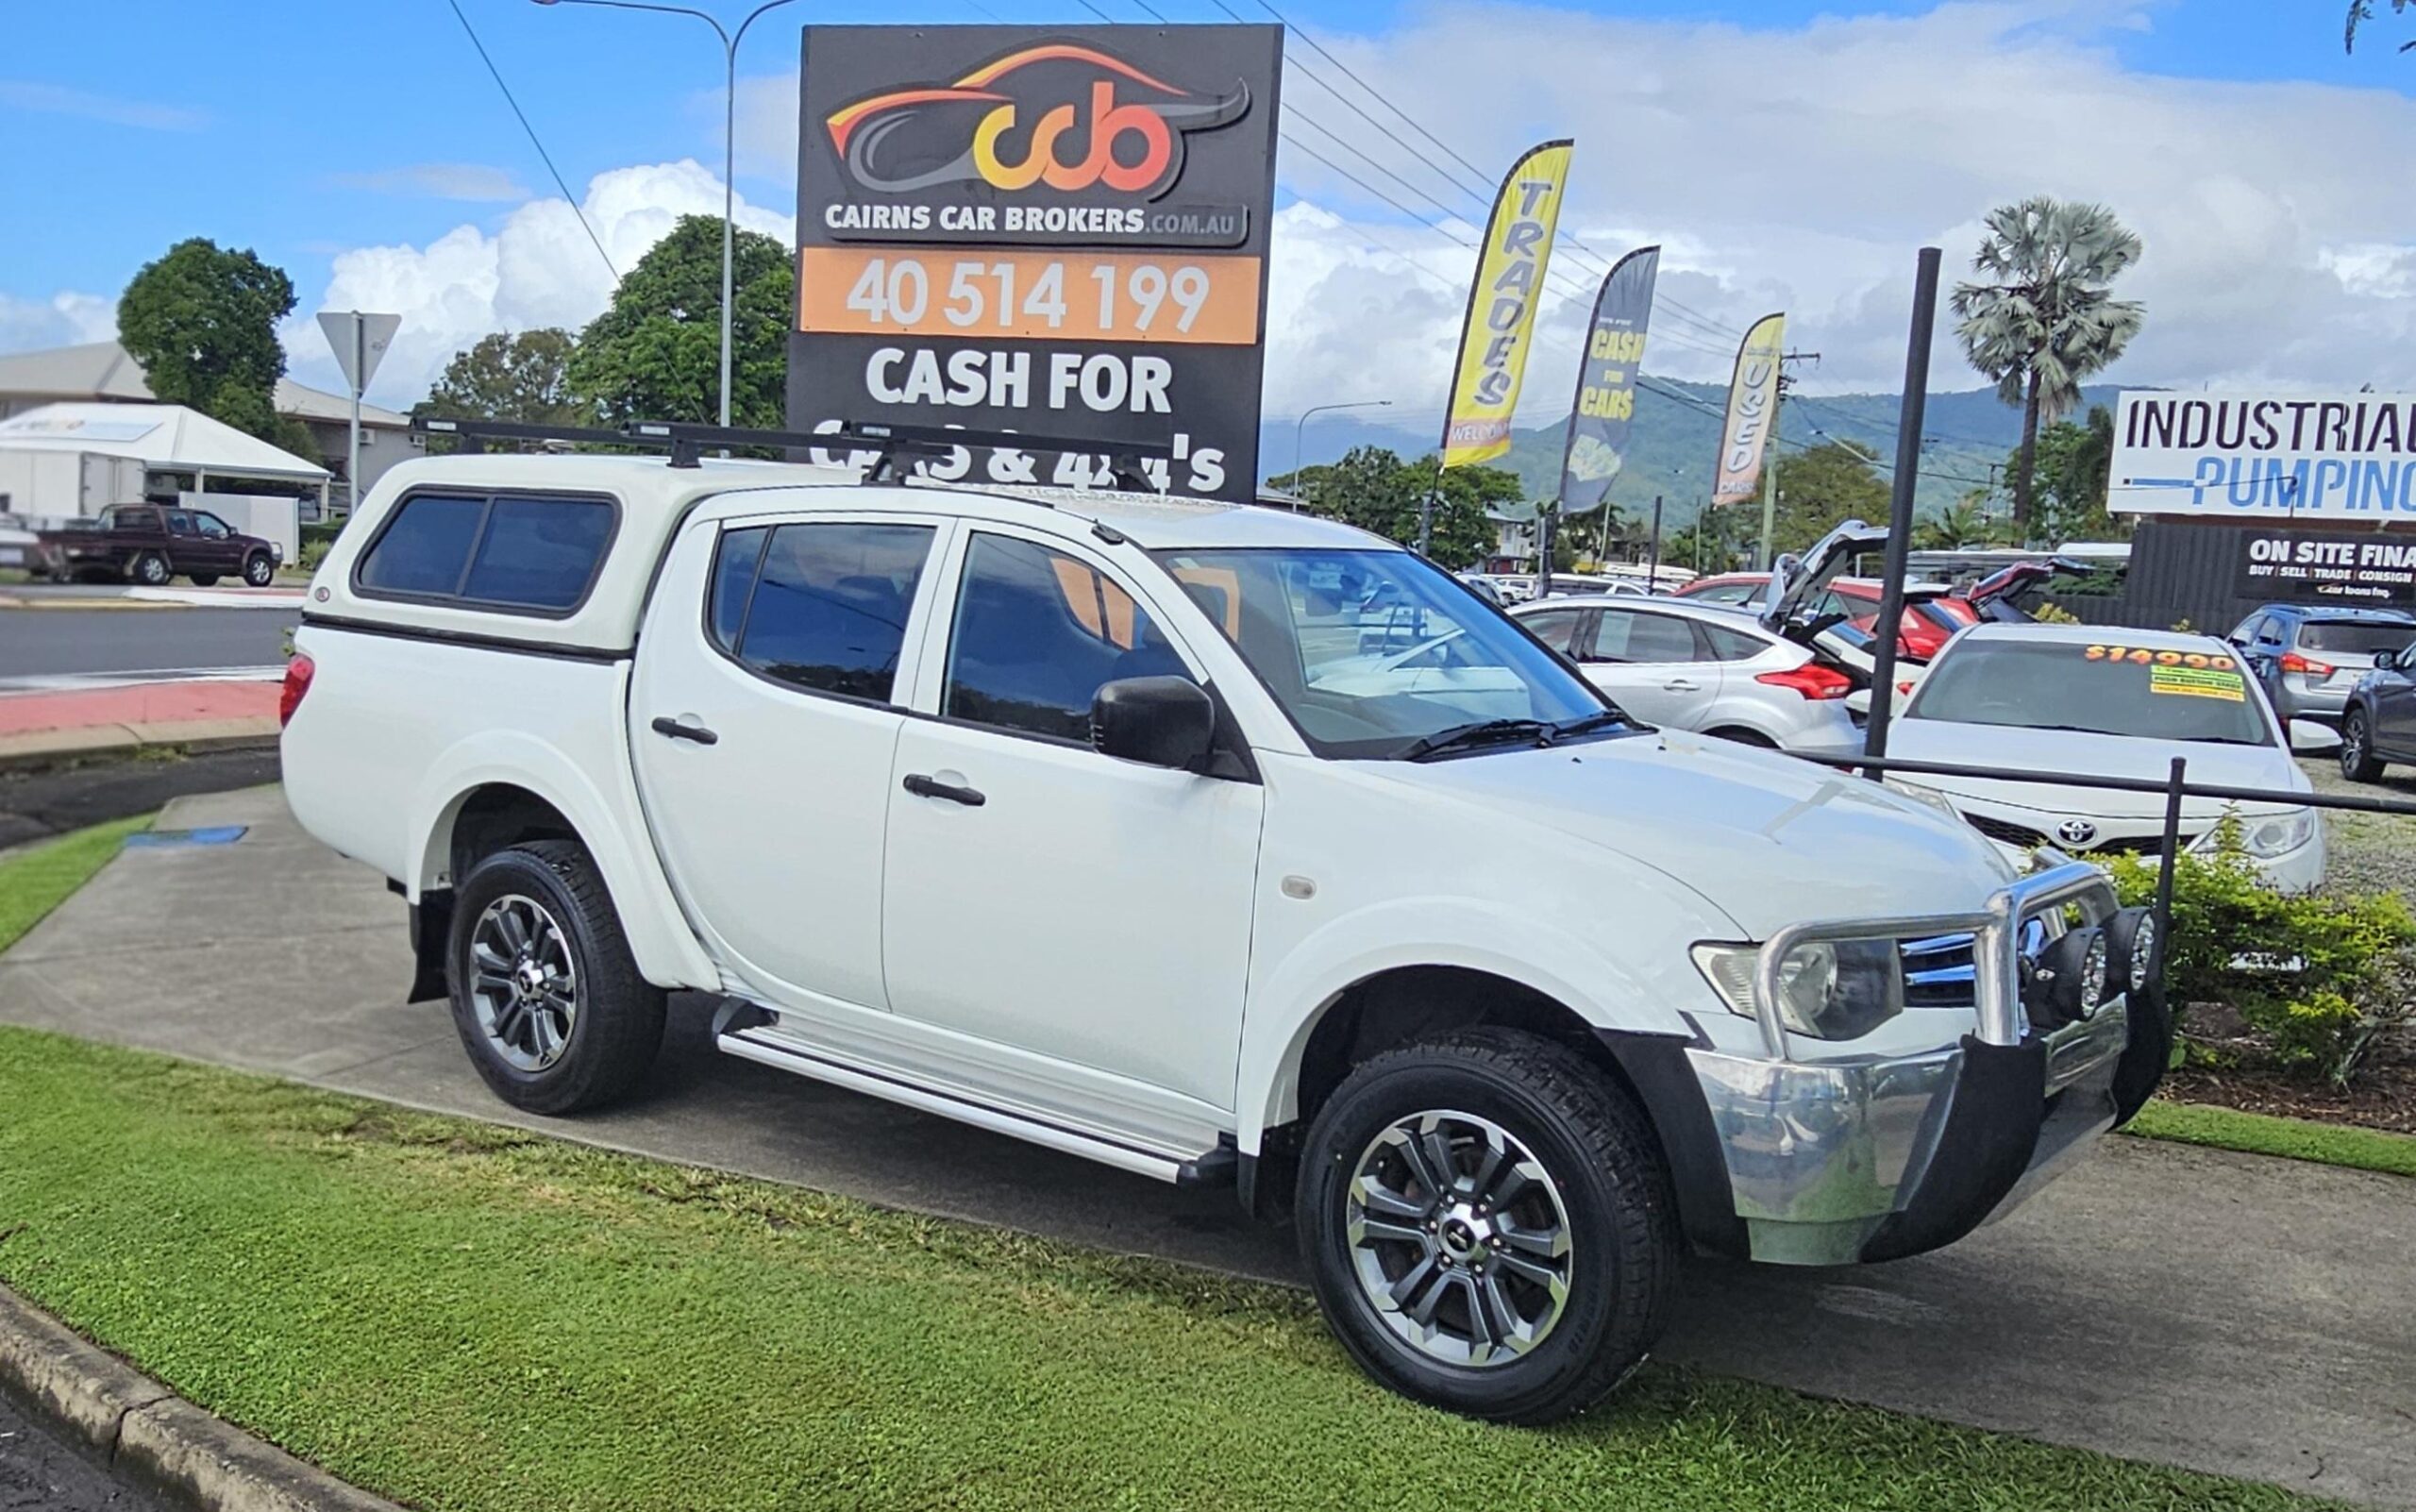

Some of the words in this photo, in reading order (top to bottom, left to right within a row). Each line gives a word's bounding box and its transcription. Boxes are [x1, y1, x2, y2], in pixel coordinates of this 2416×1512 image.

[825, 204, 931, 230] CAIRNS
[939, 207, 997, 232] CAR
[847, 259, 928, 326] 40
[944, 261, 1066, 328] 514
[1090, 264, 1210, 333] 199
[1473, 181, 1552, 406] TRADES
[866, 347, 1031, 409] CASH
[1049, 353, 1172, 413] FOR
[1726, 361, 1771, 473] USED
[2249, 539, 2291, 562] ON
[2295, 541, 2357, 564] SITE
[2249, 563, 2274, 576] BUY
[2279, 565, 2307, 578] SELL
[2314, 568, 2351, 580] TRADE
[2358, 570, 2413, 583] CONSIGN
